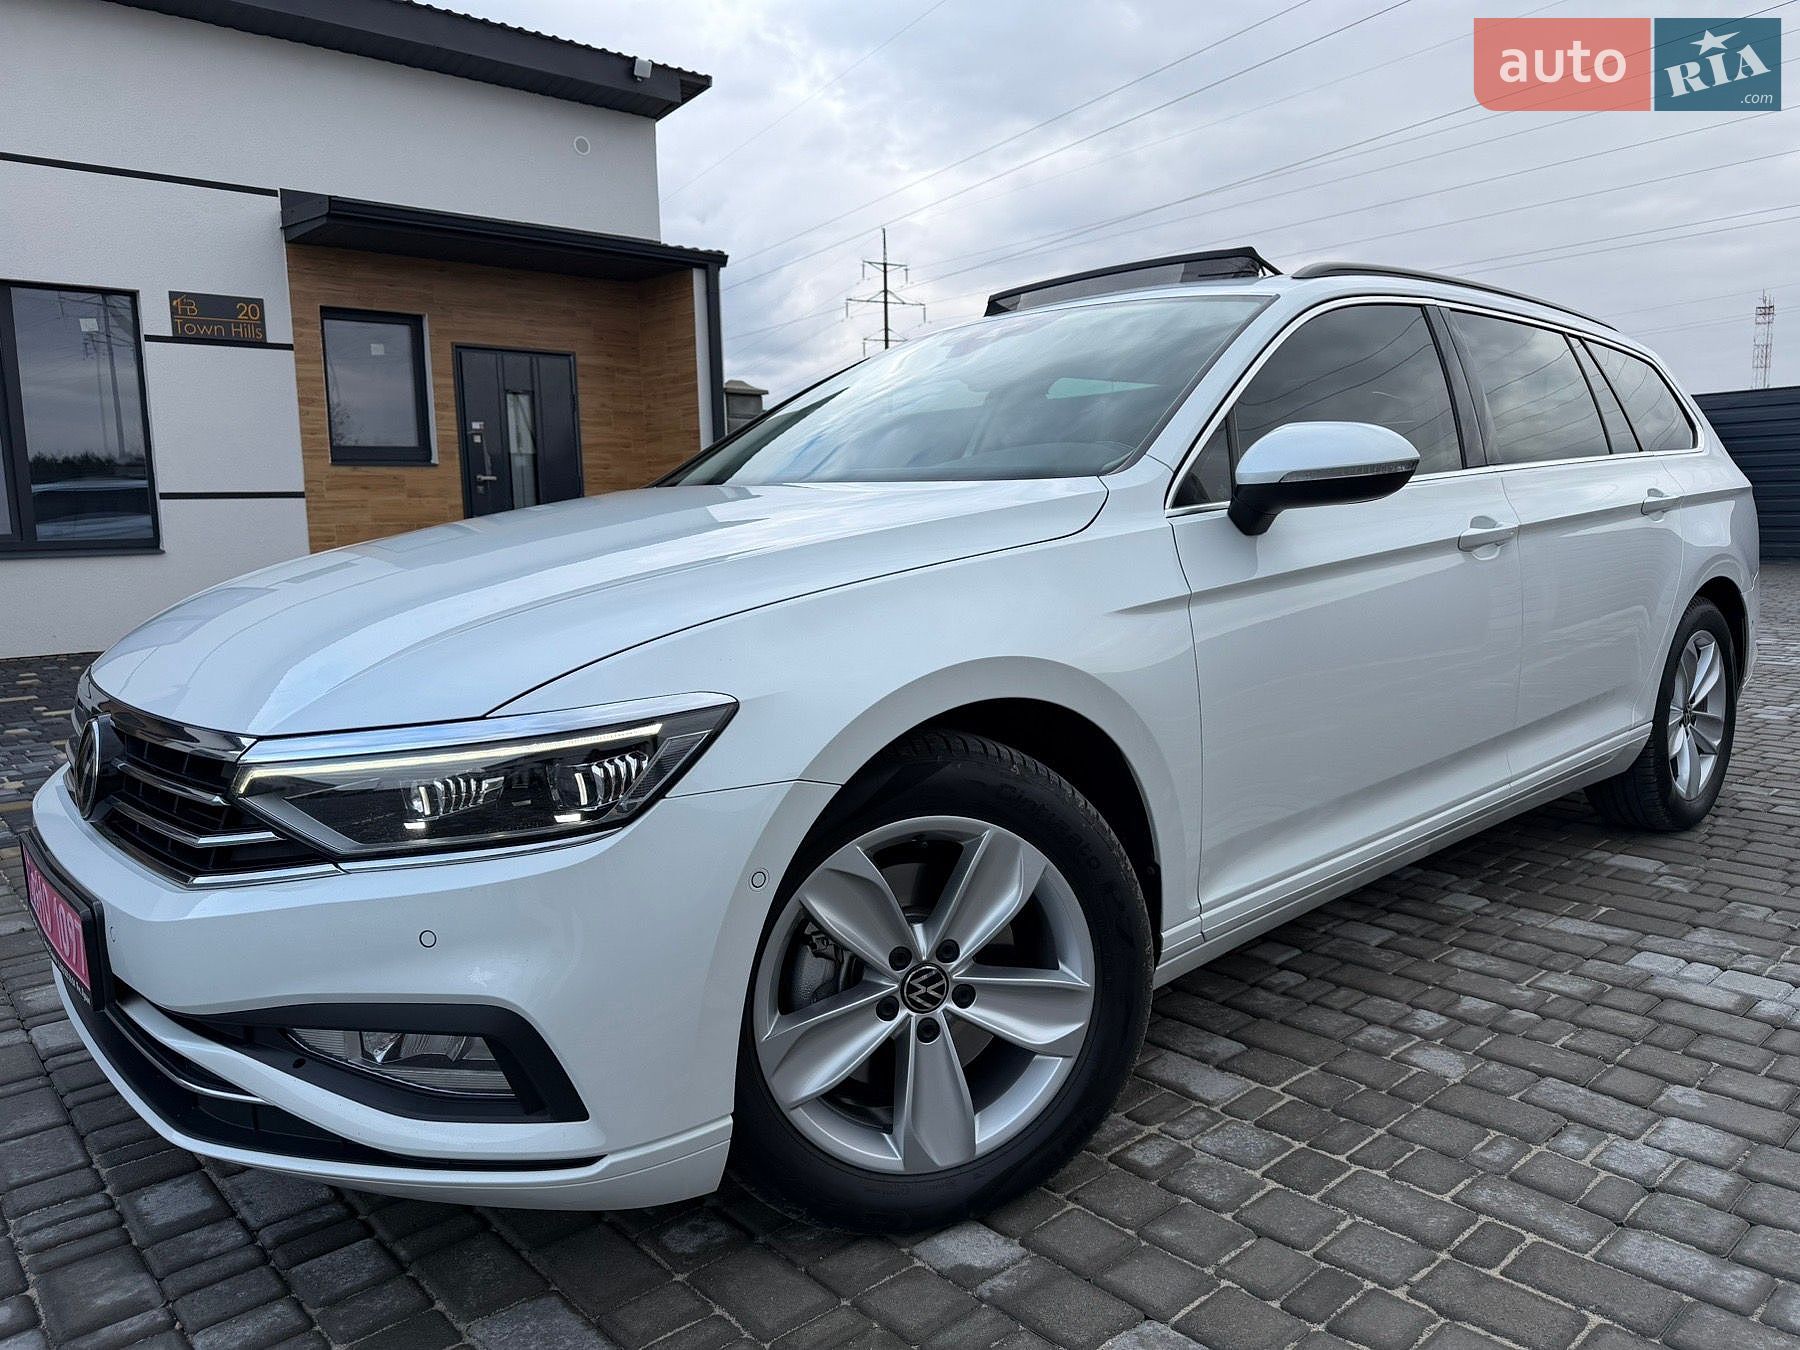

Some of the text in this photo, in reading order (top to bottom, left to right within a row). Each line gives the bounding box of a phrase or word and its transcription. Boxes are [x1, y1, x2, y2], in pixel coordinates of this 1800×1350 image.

[236, 302, 261, 320] 20
[174, 319, 263, 339] Town Hills
